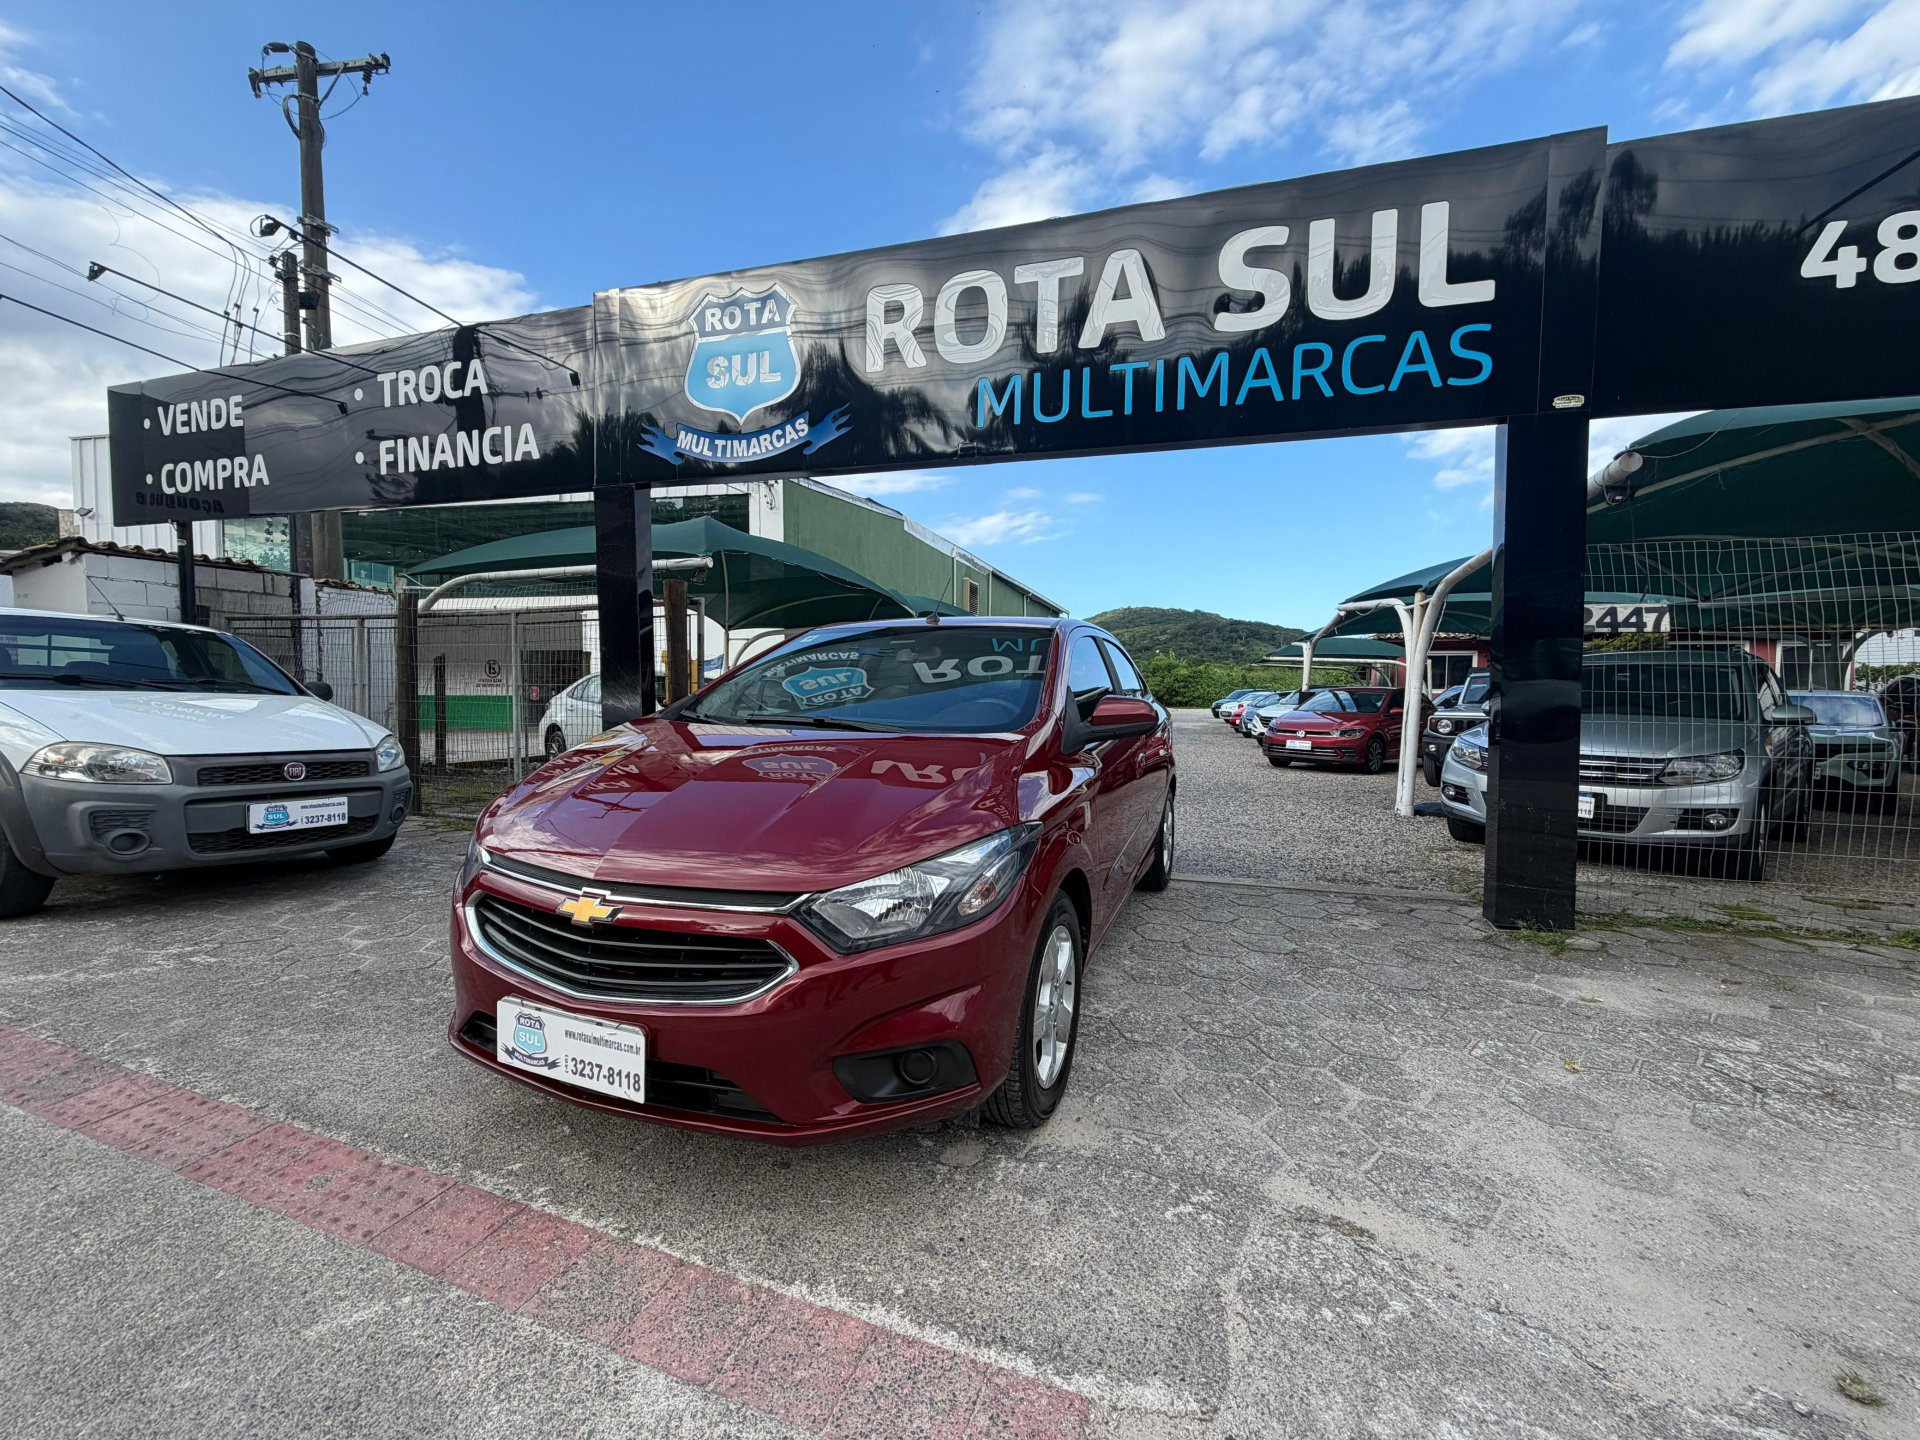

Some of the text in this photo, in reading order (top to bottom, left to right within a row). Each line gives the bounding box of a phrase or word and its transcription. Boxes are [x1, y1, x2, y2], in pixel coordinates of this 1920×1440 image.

[1800, 210, 1920, 289] 48
[865, 200, 1496, 374] ROTA SUL
[705, 299, 781, 332] ROTA
[377, 358, 488, 408] TROCA
[705, 351, 782, 389] SUL
[975, 323, 1494, 429] MULTIMARCAS
[157, 395, 244, 436] VENDE
[379, 423, 540, 475] FINANCIA
[676, 417, 809, 458] MULTIMARCAS
[160, 454, 270, 495] COMPRA
[289, 767, 302, 777] FIAT
[304, 812, 346, 824] 3237-8118
[518, 1031, 542, 1047] SUL
[519, 1017, 541, 1029] ROTA
[564, 1029, 641, 1056] www.rotasulmultimarcas.com.br
[570, 1057, 641, 1093] 3237-8118
